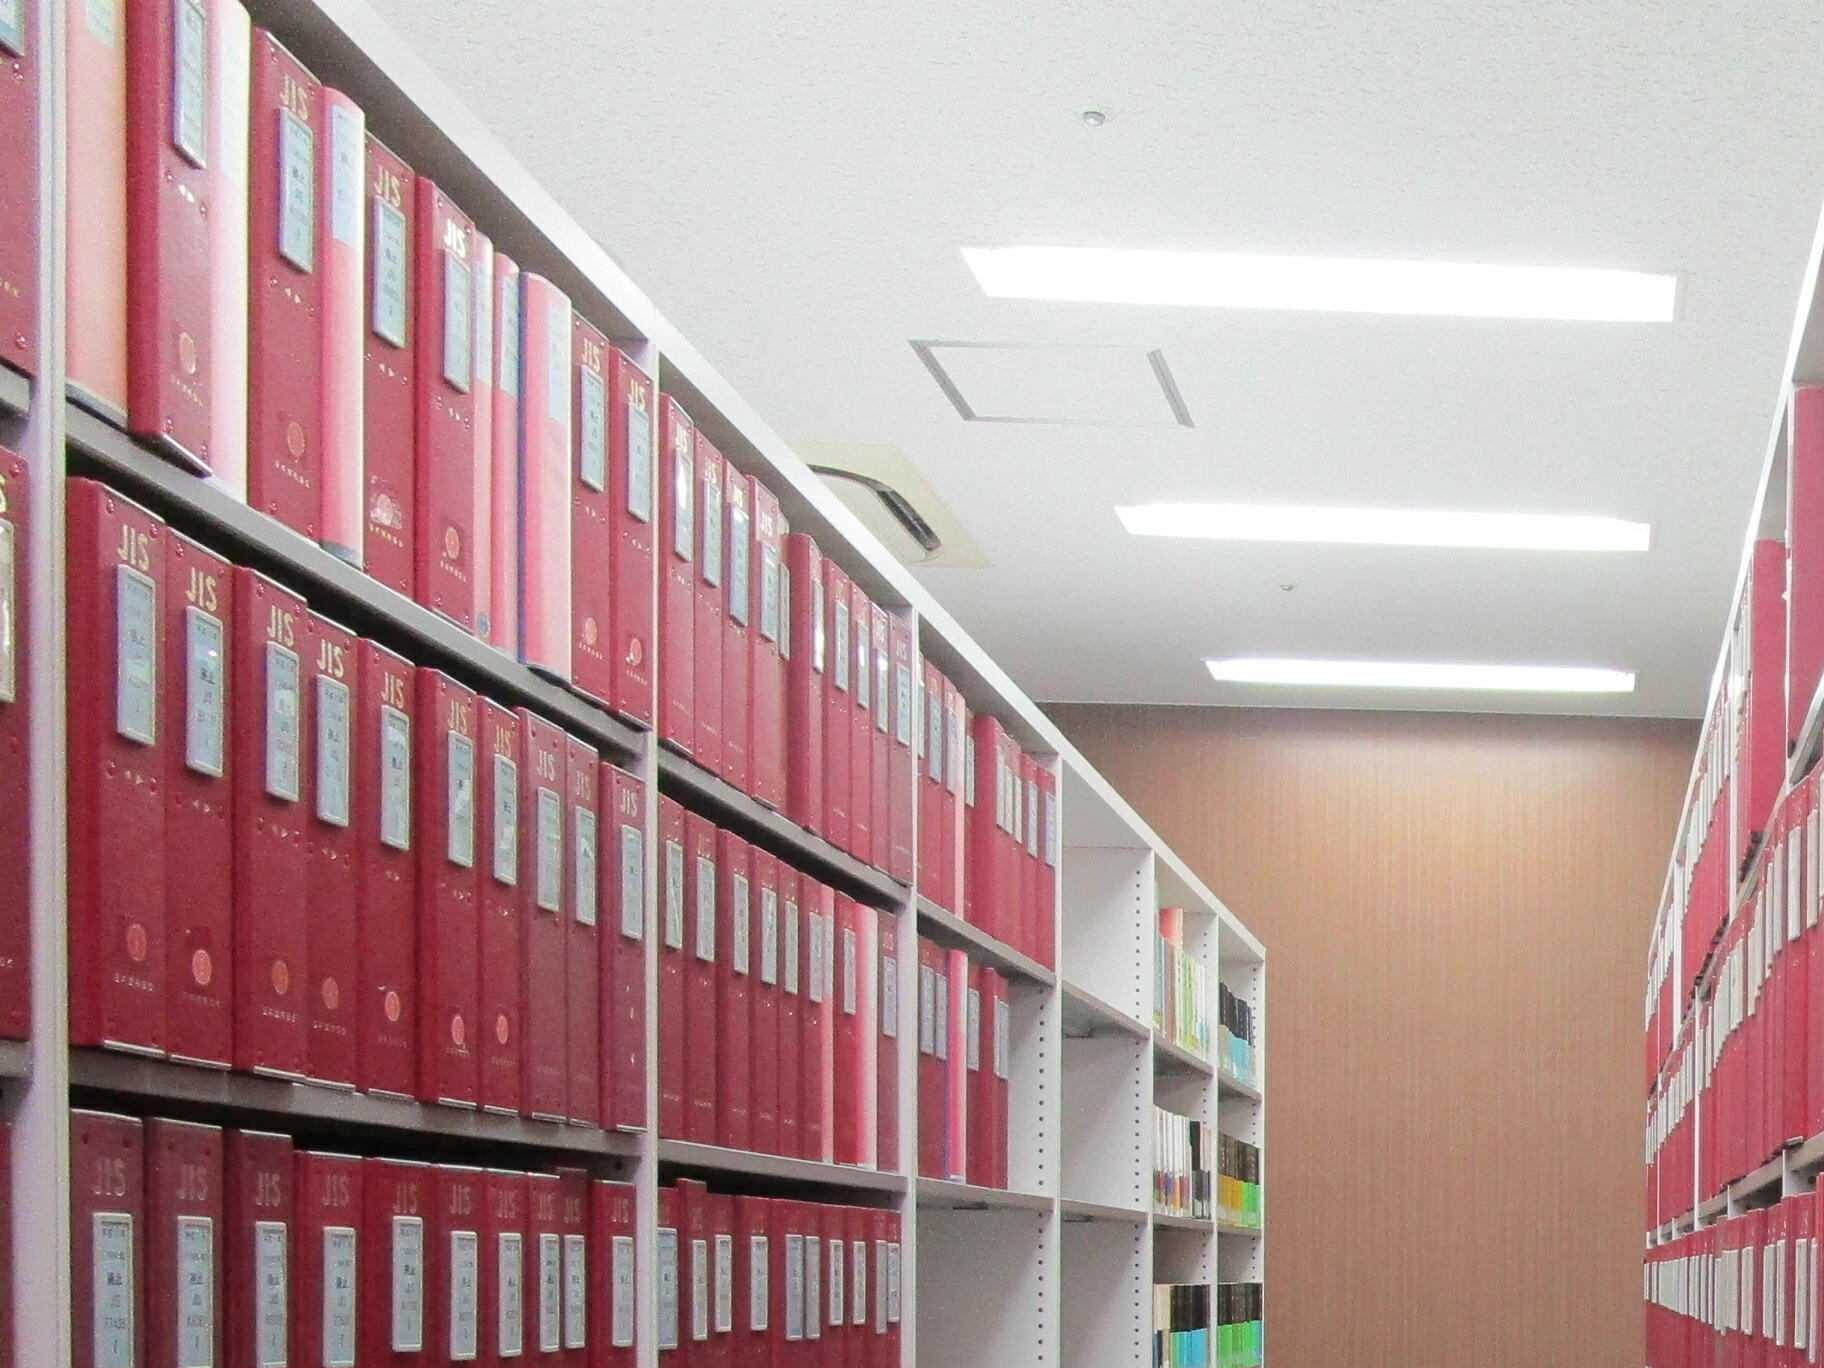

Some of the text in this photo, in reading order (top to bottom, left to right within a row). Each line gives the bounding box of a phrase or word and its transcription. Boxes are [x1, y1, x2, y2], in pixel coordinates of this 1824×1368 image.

[280, 74, 309, 121] JIS
[374, 165, 401, 207] JIS
[444, 217, 467, 258] JIS
[581, 339, 601, 372] JIS
[628, 378, 646, 411] JIS
[117, 524, 149, 571] JIS
[186, 567, 218, 612] JIS
[266, 605, 294, 647] JIS
[316, 638, 345, 679] JIS
[381, 671, 405, 709] JIS
[448, 700, 468, 734] JIS
[537, 749, 556, 781] JIS
[575, 769, 591, 801] JIS
[620, 788, 638, 818] JIS
[93, 1157, 127, 1196] JIS
[178, 1163, 208, 1201] JIS
[256, 1172, 281, 1207] JIS
[323, 1174, 349, 1207] JIS
[450, 1185, 471, 1215] JIS
